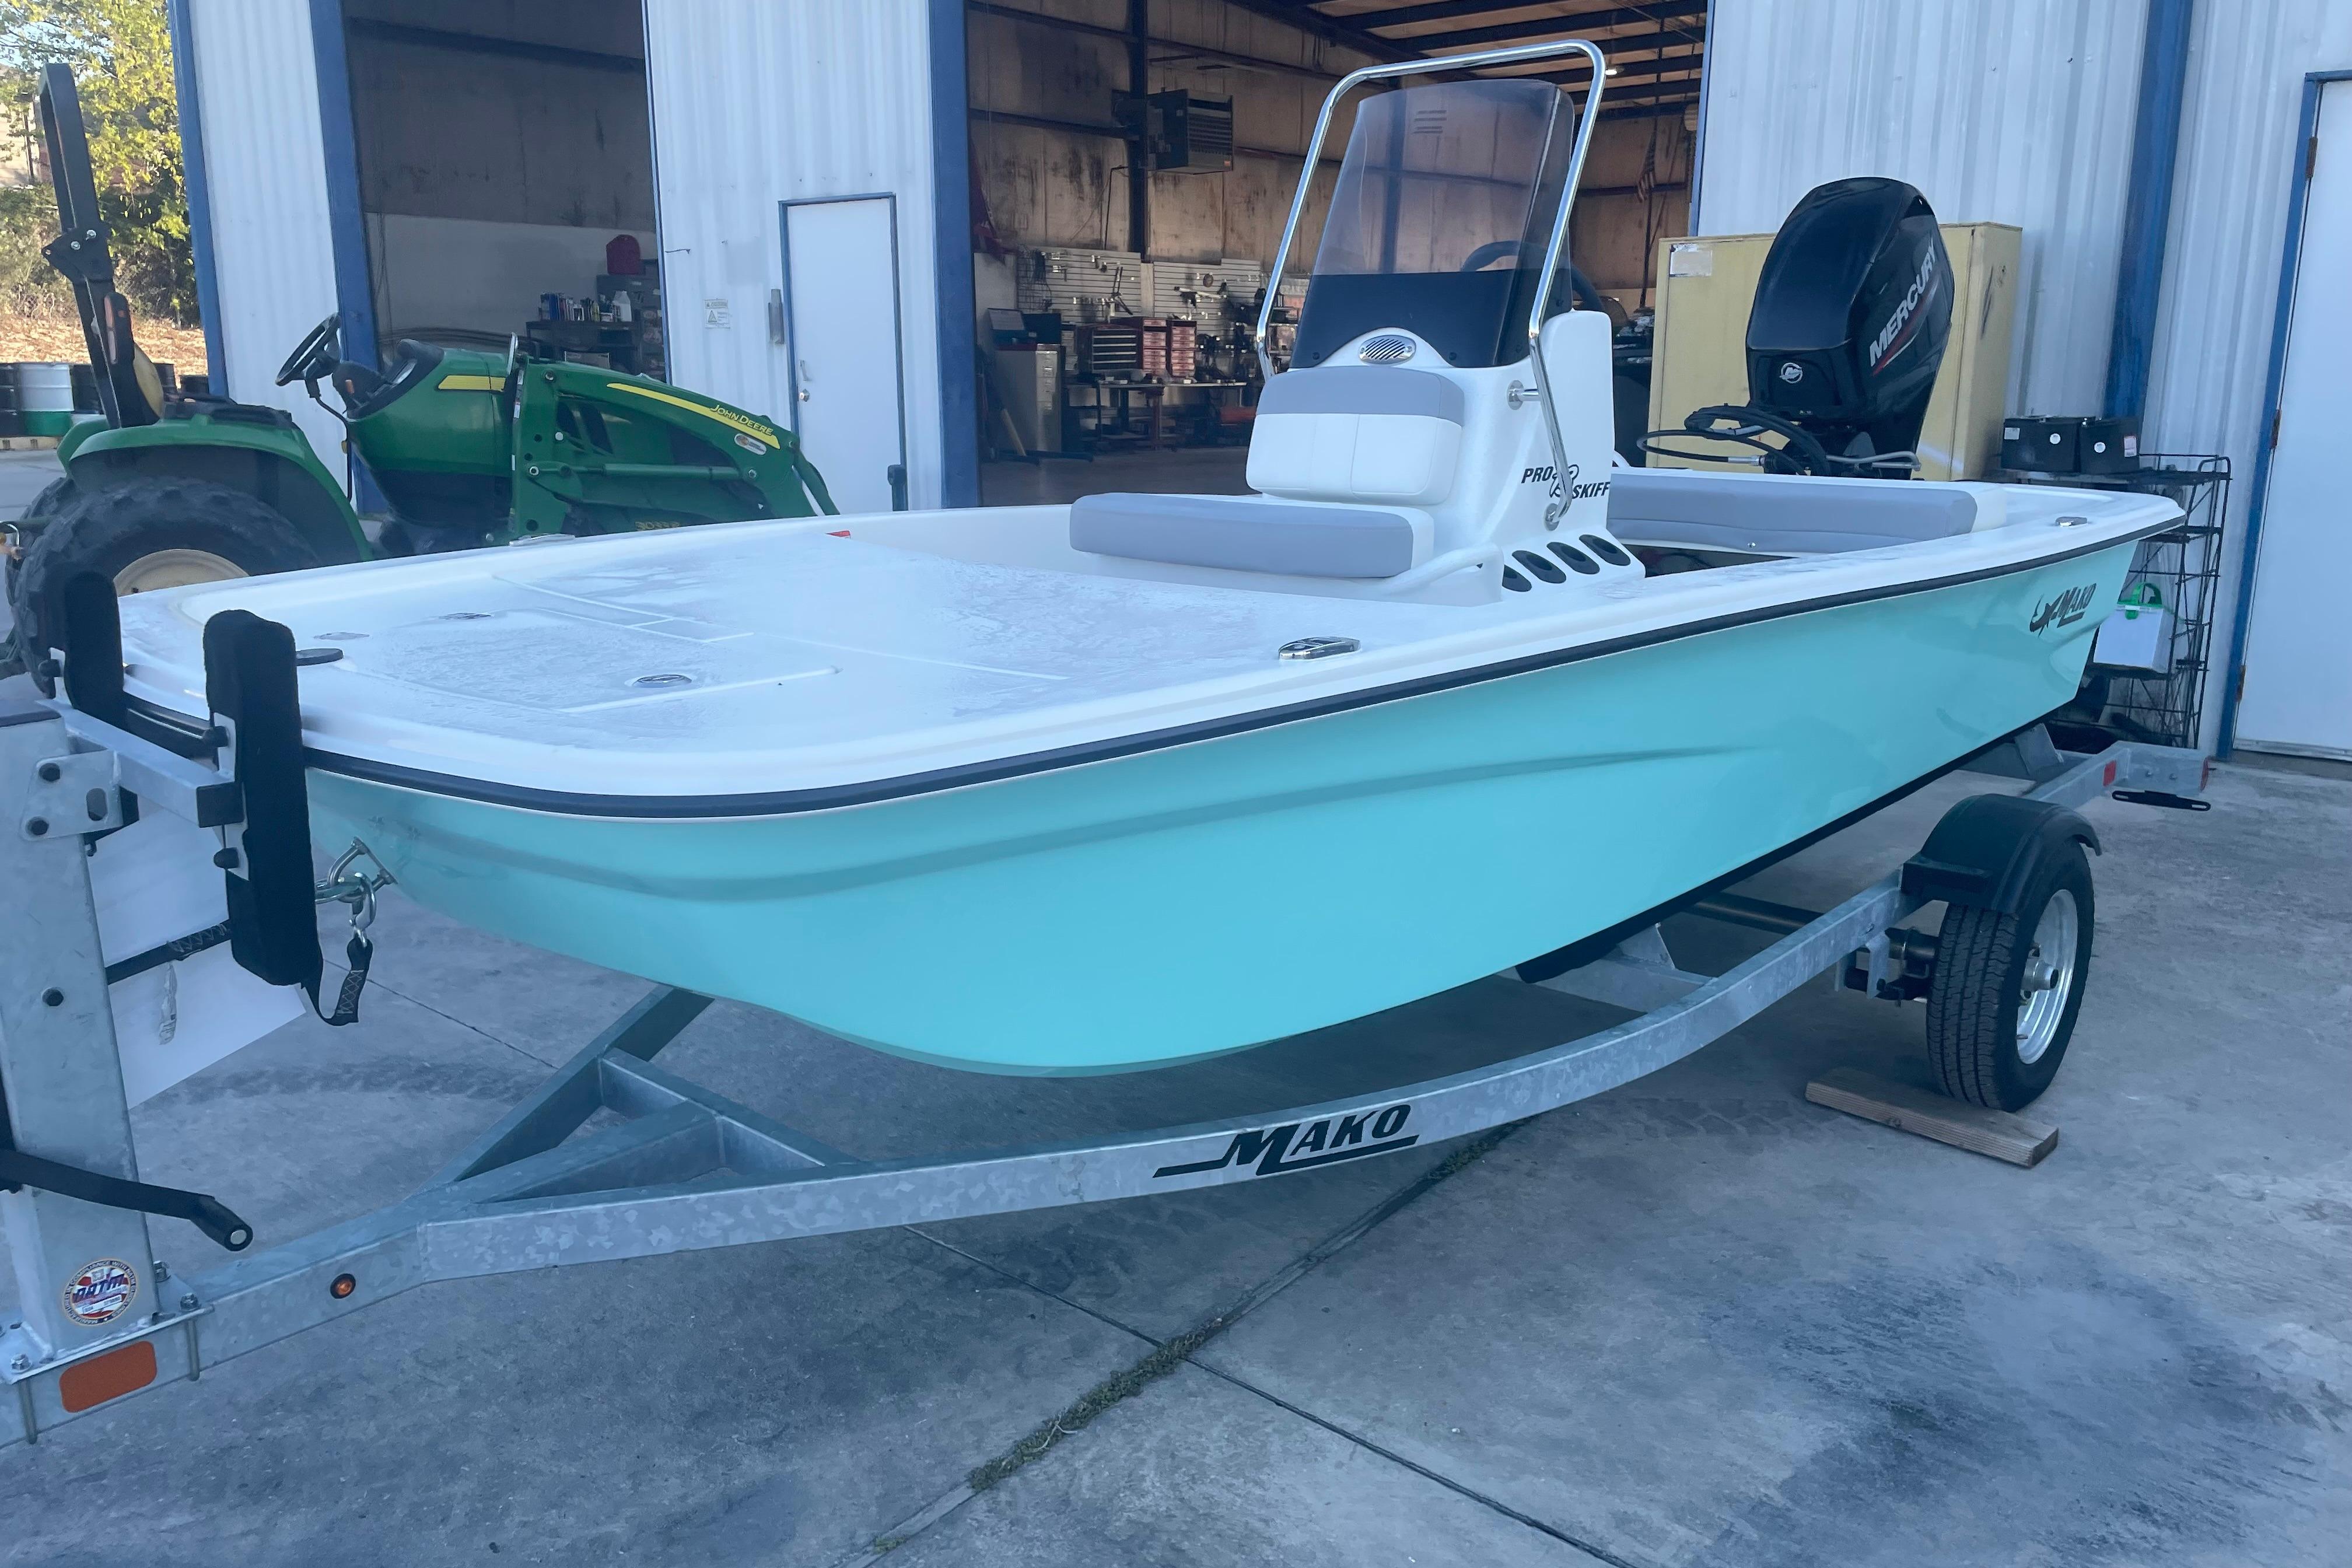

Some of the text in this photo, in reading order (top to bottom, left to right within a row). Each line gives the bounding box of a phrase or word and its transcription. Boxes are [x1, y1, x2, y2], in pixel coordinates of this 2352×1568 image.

[1869, 237, 1936, 367] MERCURY
[709, 405, 774, 436] JOHN DEERE
[1521, 466, 1553, 484] PRO
[1572, 481, 1611, 499] SKIFF
[2049, 583, 2097, 628] MAKO
[1153, 1105, 1419, 1176] MAKO
